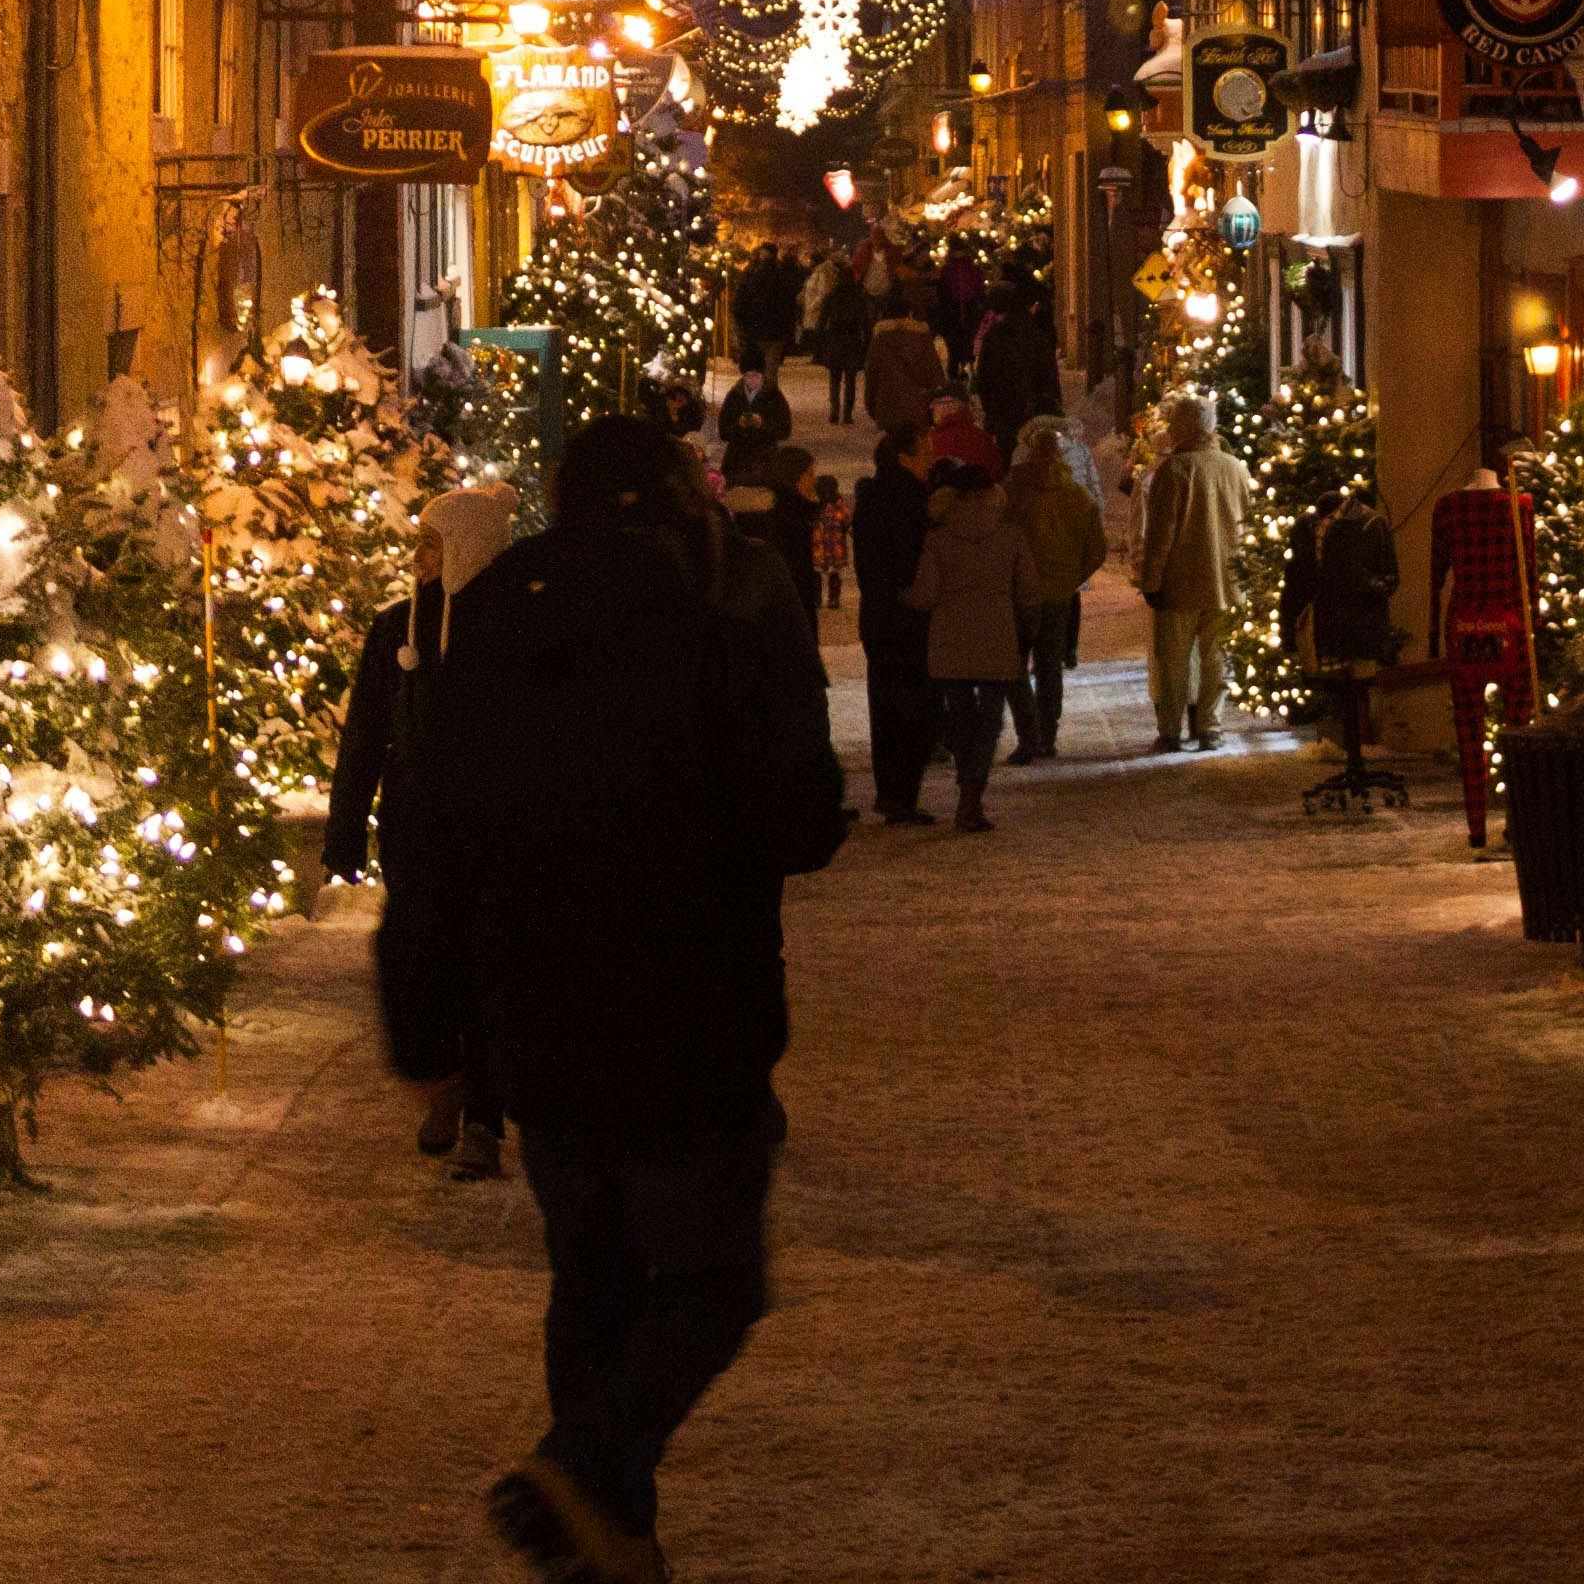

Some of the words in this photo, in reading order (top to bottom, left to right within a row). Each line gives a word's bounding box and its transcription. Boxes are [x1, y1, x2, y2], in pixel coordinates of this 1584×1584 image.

[1461, 22, 1509, 61] RED
[493, 63, 610, 89] FLAMAND
[386, 83, 477, 107] JOAILLERIE
[342, 107, 395, 134] Jules
[362, 128, 468, 161] PERRIER
[489, 129, 609, 177] Sculpteur
